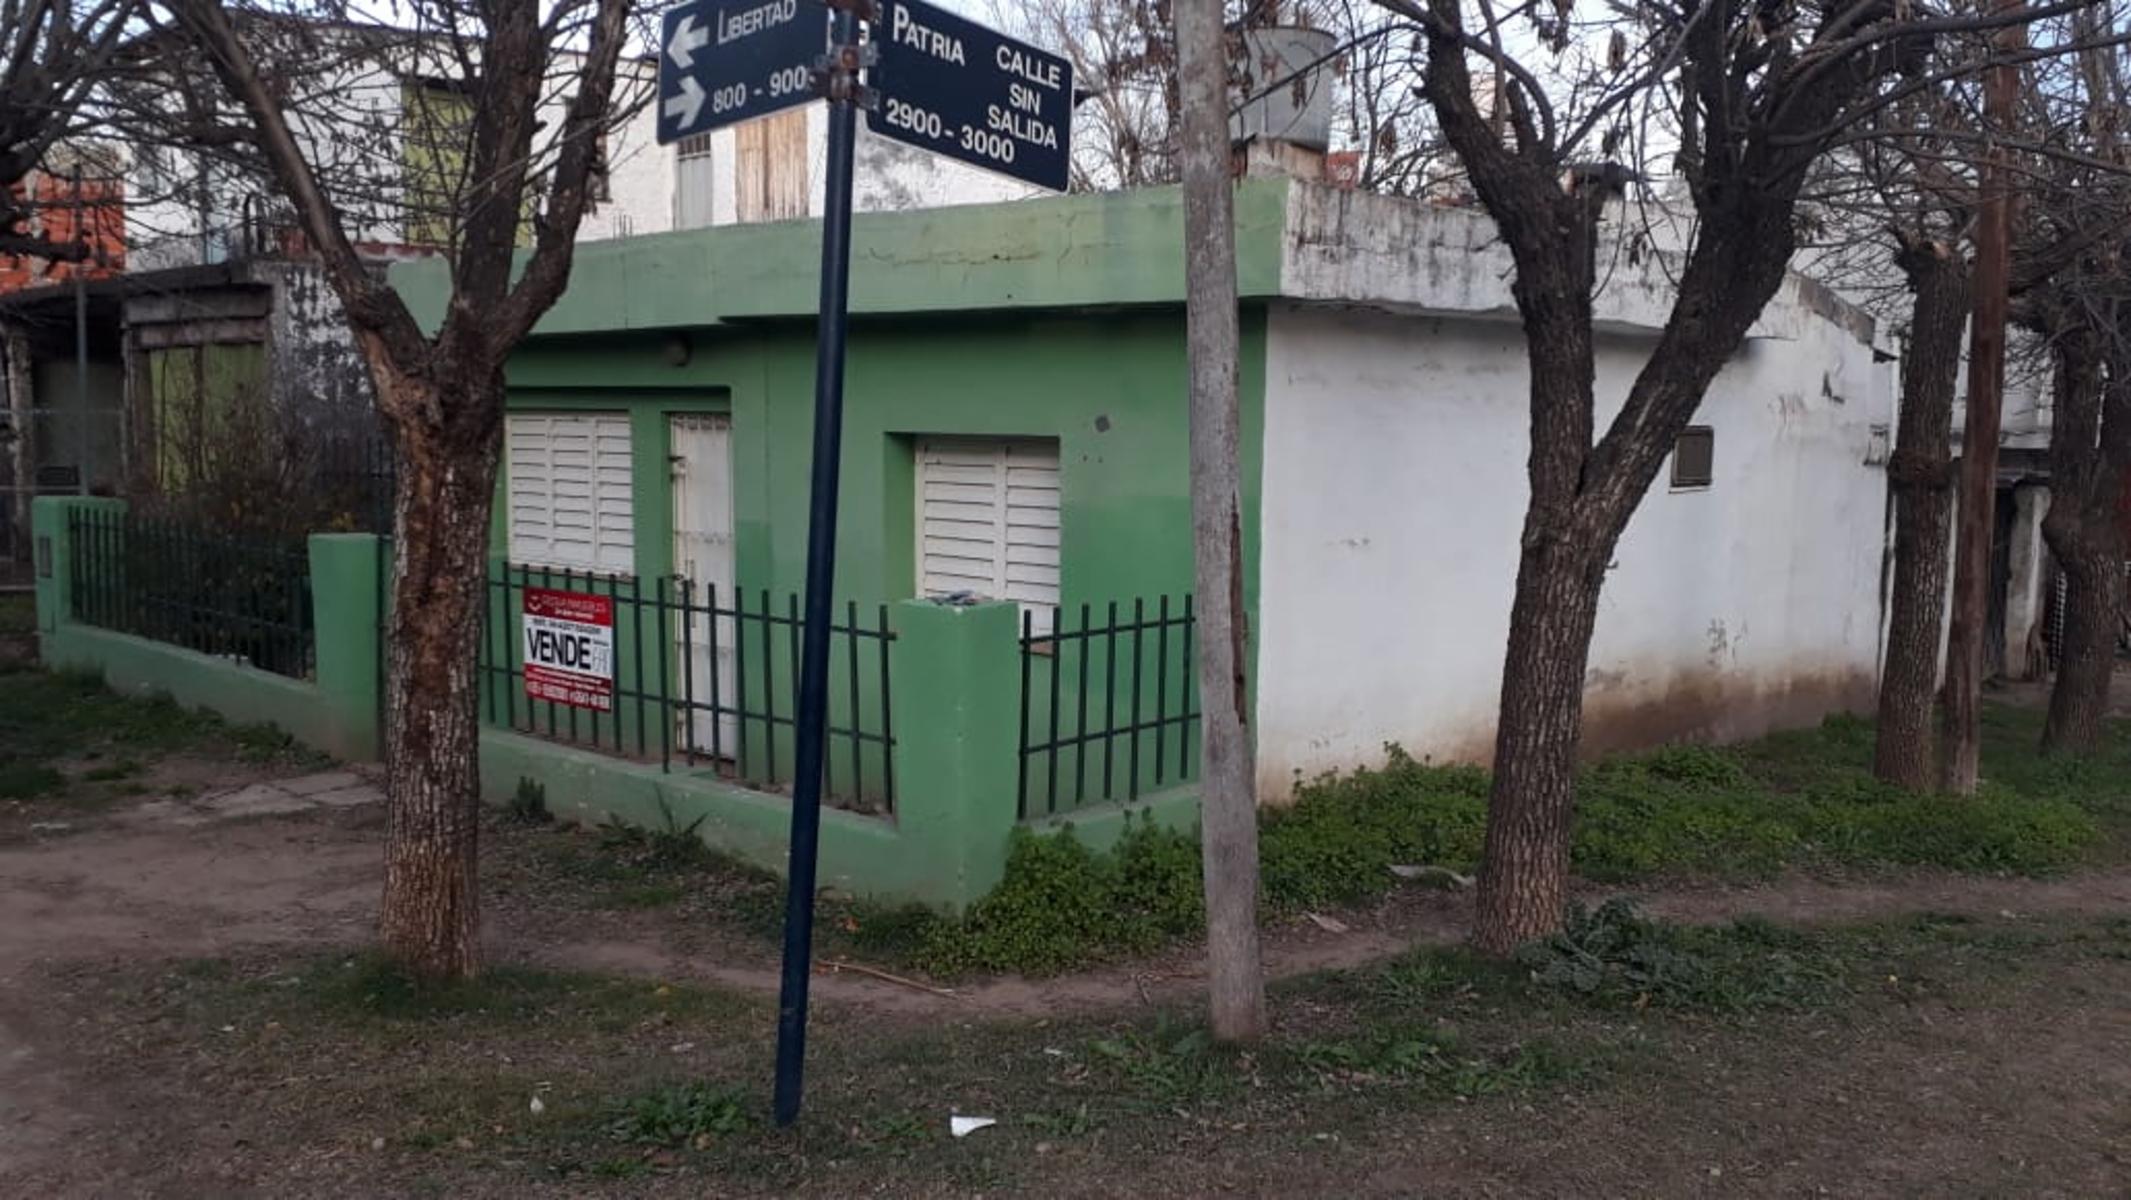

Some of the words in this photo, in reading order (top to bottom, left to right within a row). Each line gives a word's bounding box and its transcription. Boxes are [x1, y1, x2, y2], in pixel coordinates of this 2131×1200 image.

[717, 0, 796, 45] LIBERTAD
[893, 3, 966, 67] PATRIA
[712, 82, 747, 114] 800
[769, 65, 808, 98] 900
[996, 44, 1061, 90] CALLE
[1009, 82, 1041, 116] SIN
[885, 98, 942, 139] 2900
[960, 124, 1016, 164] 3000
[988, 103, 1059, 150] SALIDA
[527, 627, 592, 671] VENDE
